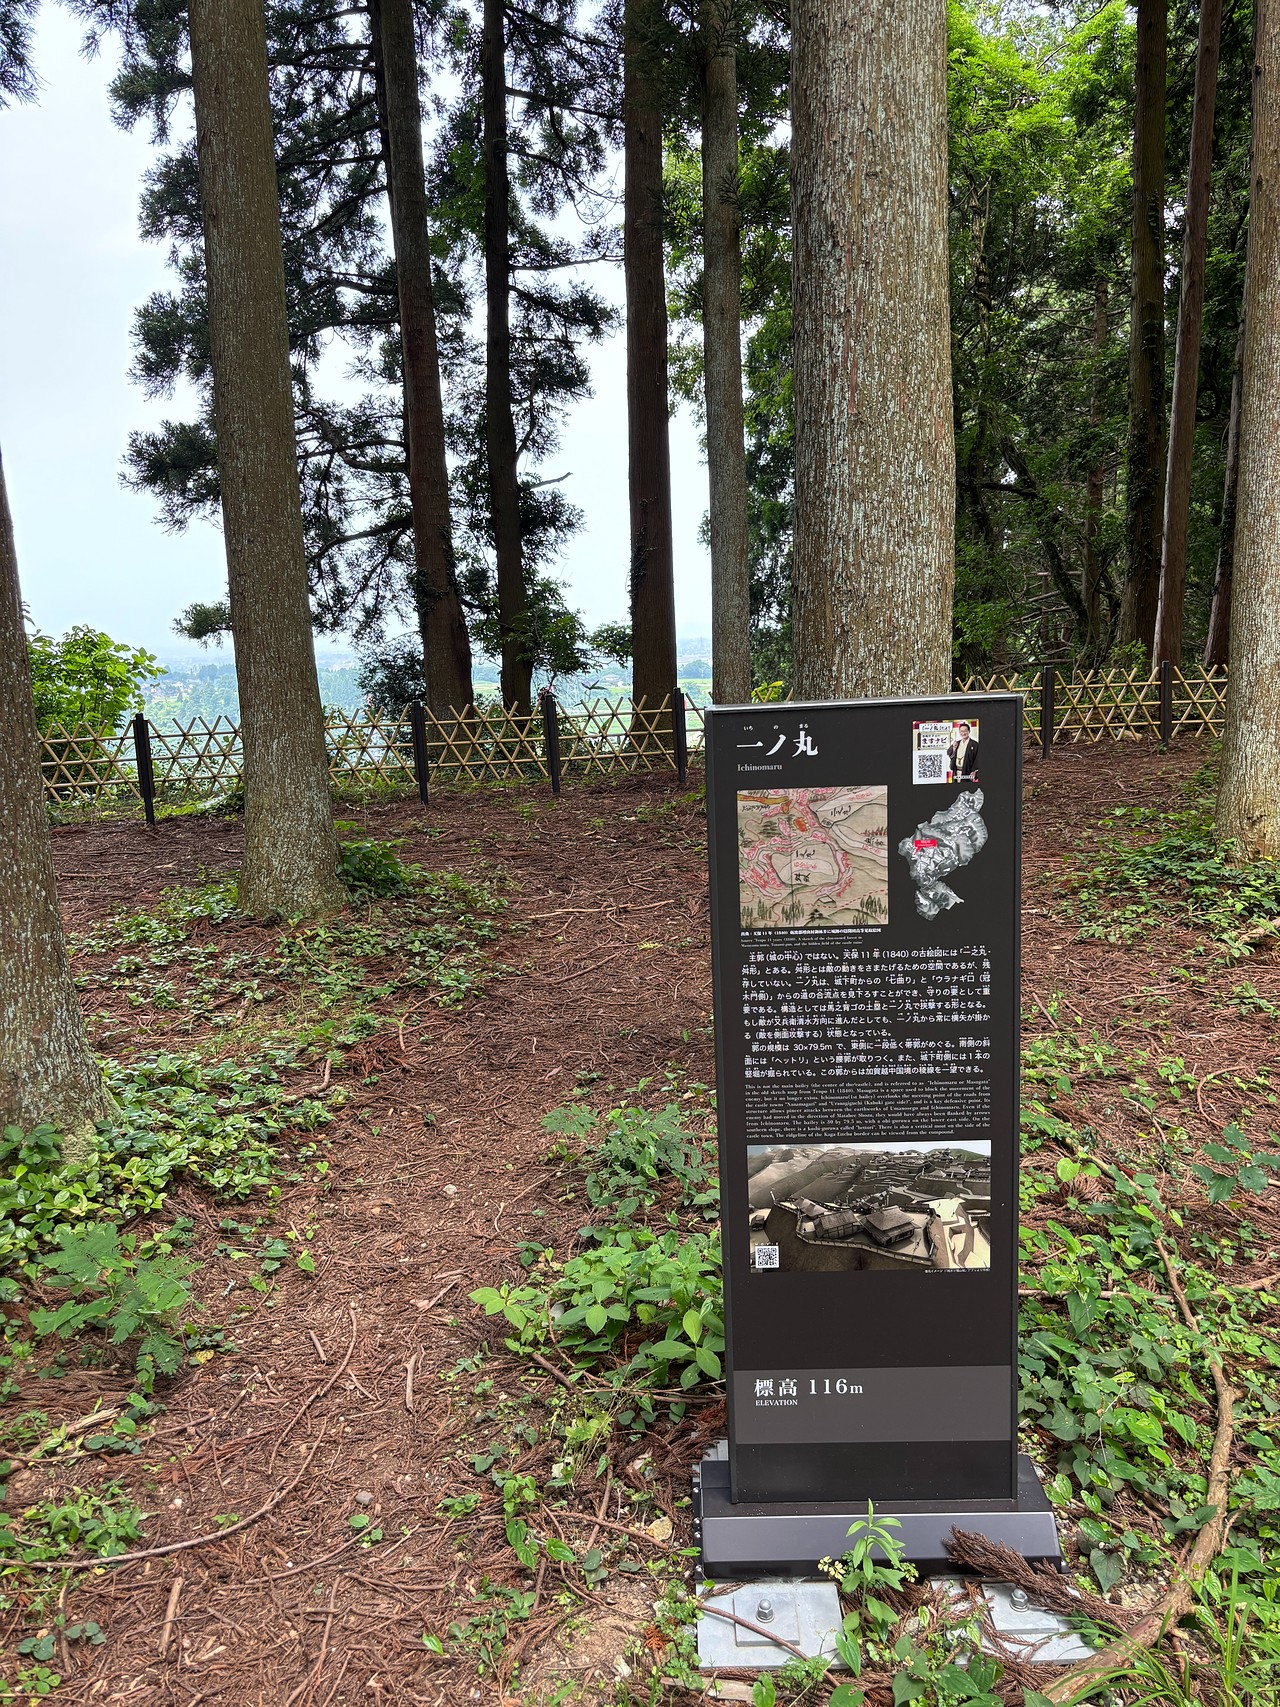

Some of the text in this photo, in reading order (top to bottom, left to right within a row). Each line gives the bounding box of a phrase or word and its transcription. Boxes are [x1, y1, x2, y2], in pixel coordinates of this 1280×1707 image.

[736, 730, 818, 758] 一ノ丸
[737, 764, 782, 772] Ichinomaru
[754, 1378, 863, 1397] 標高 116m
